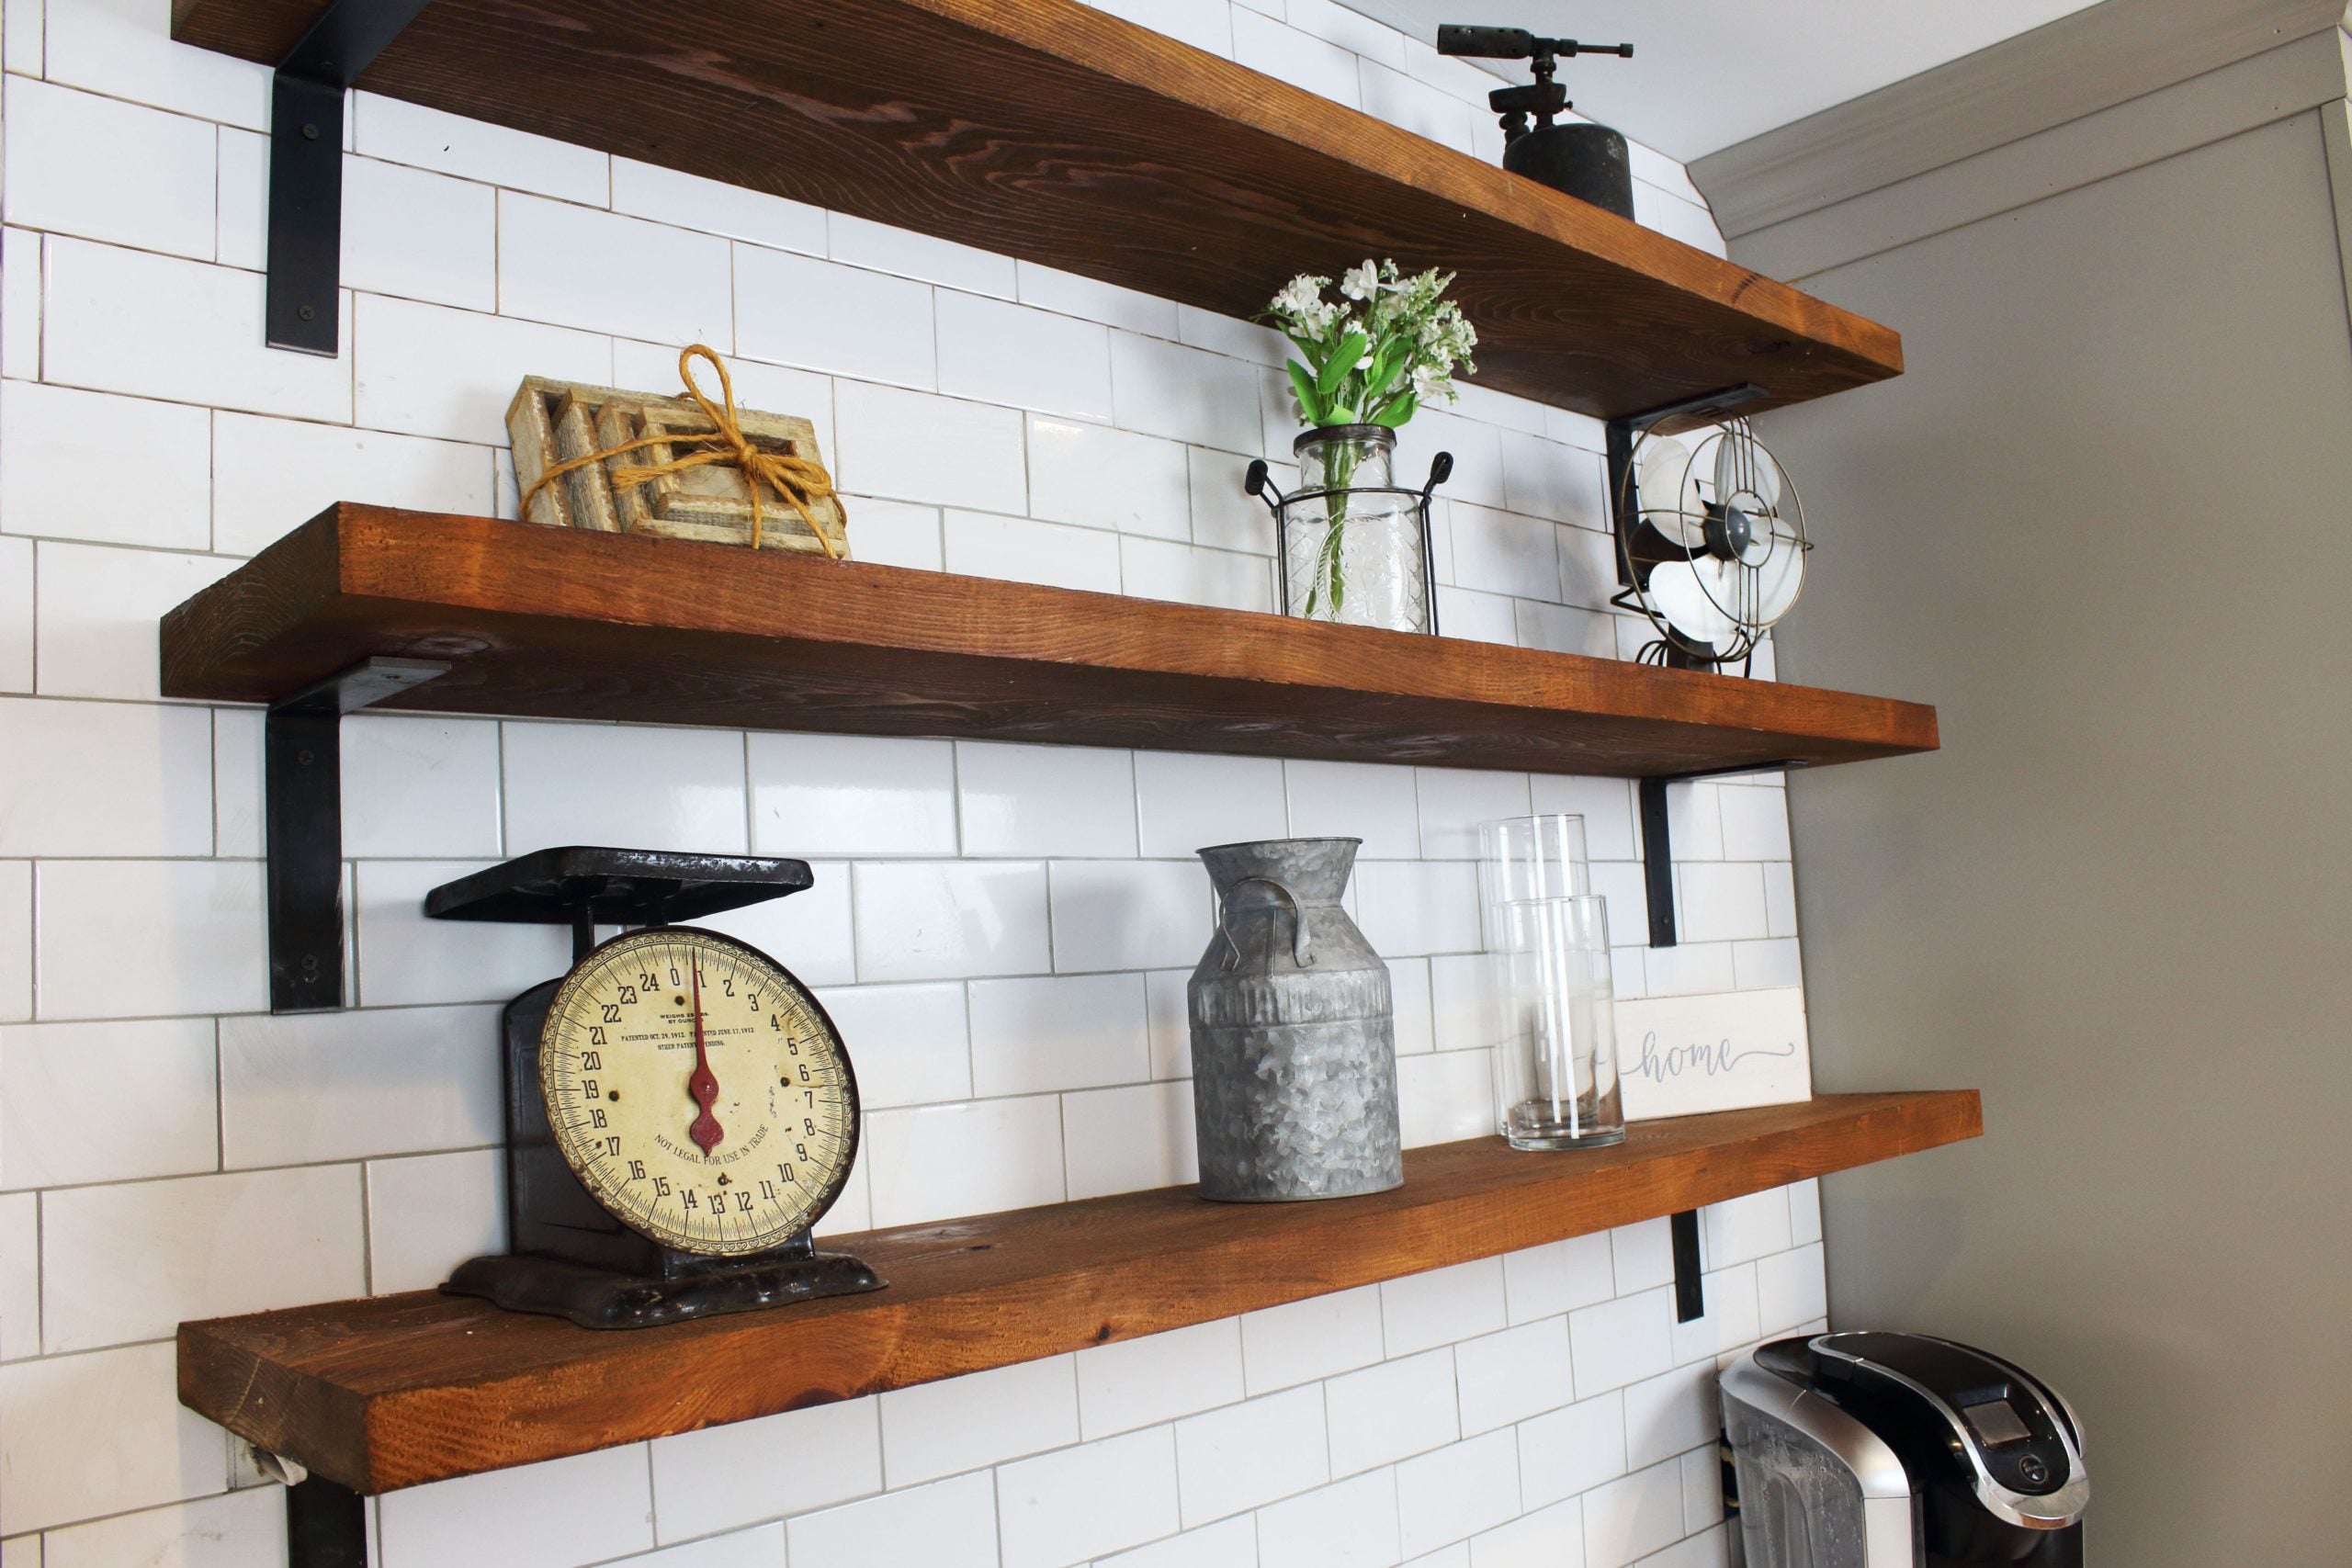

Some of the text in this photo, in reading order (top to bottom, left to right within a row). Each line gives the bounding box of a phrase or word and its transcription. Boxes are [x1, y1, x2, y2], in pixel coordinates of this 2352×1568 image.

[639, 974, 660, 991] 24
[670, 968, 680, 986] 0
[697, 970, 707, 987] 1
[617, 986, 638, 1004] 23
[723, 979, 734, 997] 2
[748, 994, 759, 1011] 3
[601, 1004, 622, 1023] 22
[771, 1014, 781, 1032] 4
[589, 1026, 607, 1045] 21
[787, 1038, 797, 1055] 5
[582, 1051, 601, 1070] 20
[1620, 1031, 1794, 1083] home
[798, 1064, 809, 1081] 6
[582, 1079, 599, 1099] 19
[804, 1091, 812, 1109] 7
[589, 1109, 607, 1128] 18
[804, 1118, 815, 1135] 8
[605, 1136, 620, 1156] 17
[654, 1123, 769, 1166] NOT LEGAL FOR USE IN TRADE
[796, 1143, 808, 1161] 9
[628, 1160, 646, 1179] 16
[777, 1163, 795, 1182] 10
[652, 1177, 671, 1197] 15
[759, 1179, 775, 1200] 11
[680, 1189, 698, 1210] 14
[707, 1194, 725, 1214] 13
[736, 1191, 753, 1211] 12
